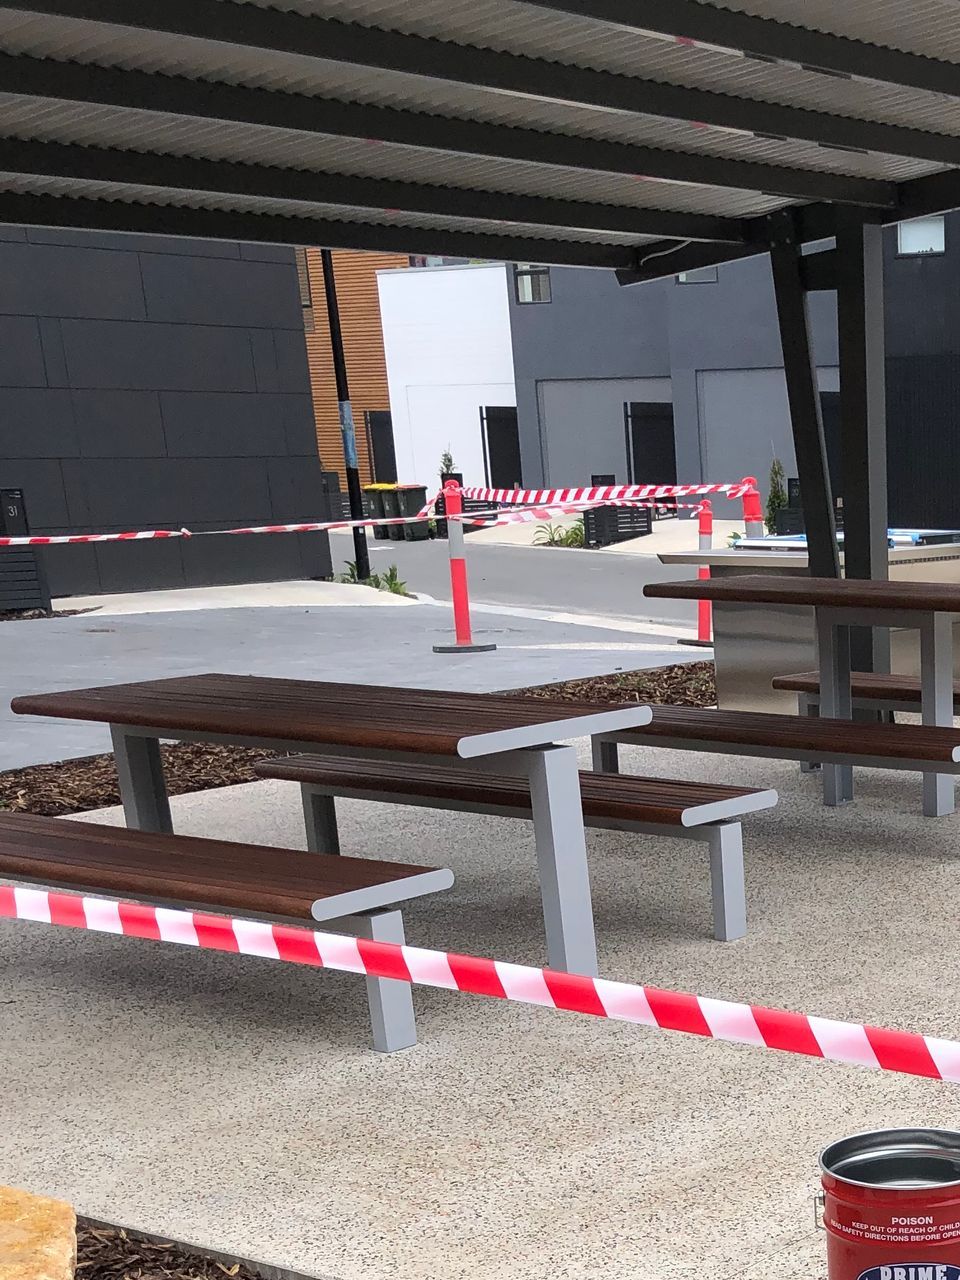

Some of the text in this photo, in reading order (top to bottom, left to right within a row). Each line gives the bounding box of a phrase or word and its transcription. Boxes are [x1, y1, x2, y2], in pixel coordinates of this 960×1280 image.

[8, 505, 18, 517] 31
[891, 1216, 933, 1225] POISON
[842, 1225, 863, 1236] SAFETY
[864, 1231, 909, 1242] DIRECTIONS
[910, 1233, 941, 1242] BEFORE
[851, 1221, 869, 1231] KEEP
[870, 1225, 885, 1233] OUT
[886, 1226, 897, 1234] OF
[899, 1226, 926, 1234] REACH
[927, 1225, 938, 1233] OF
